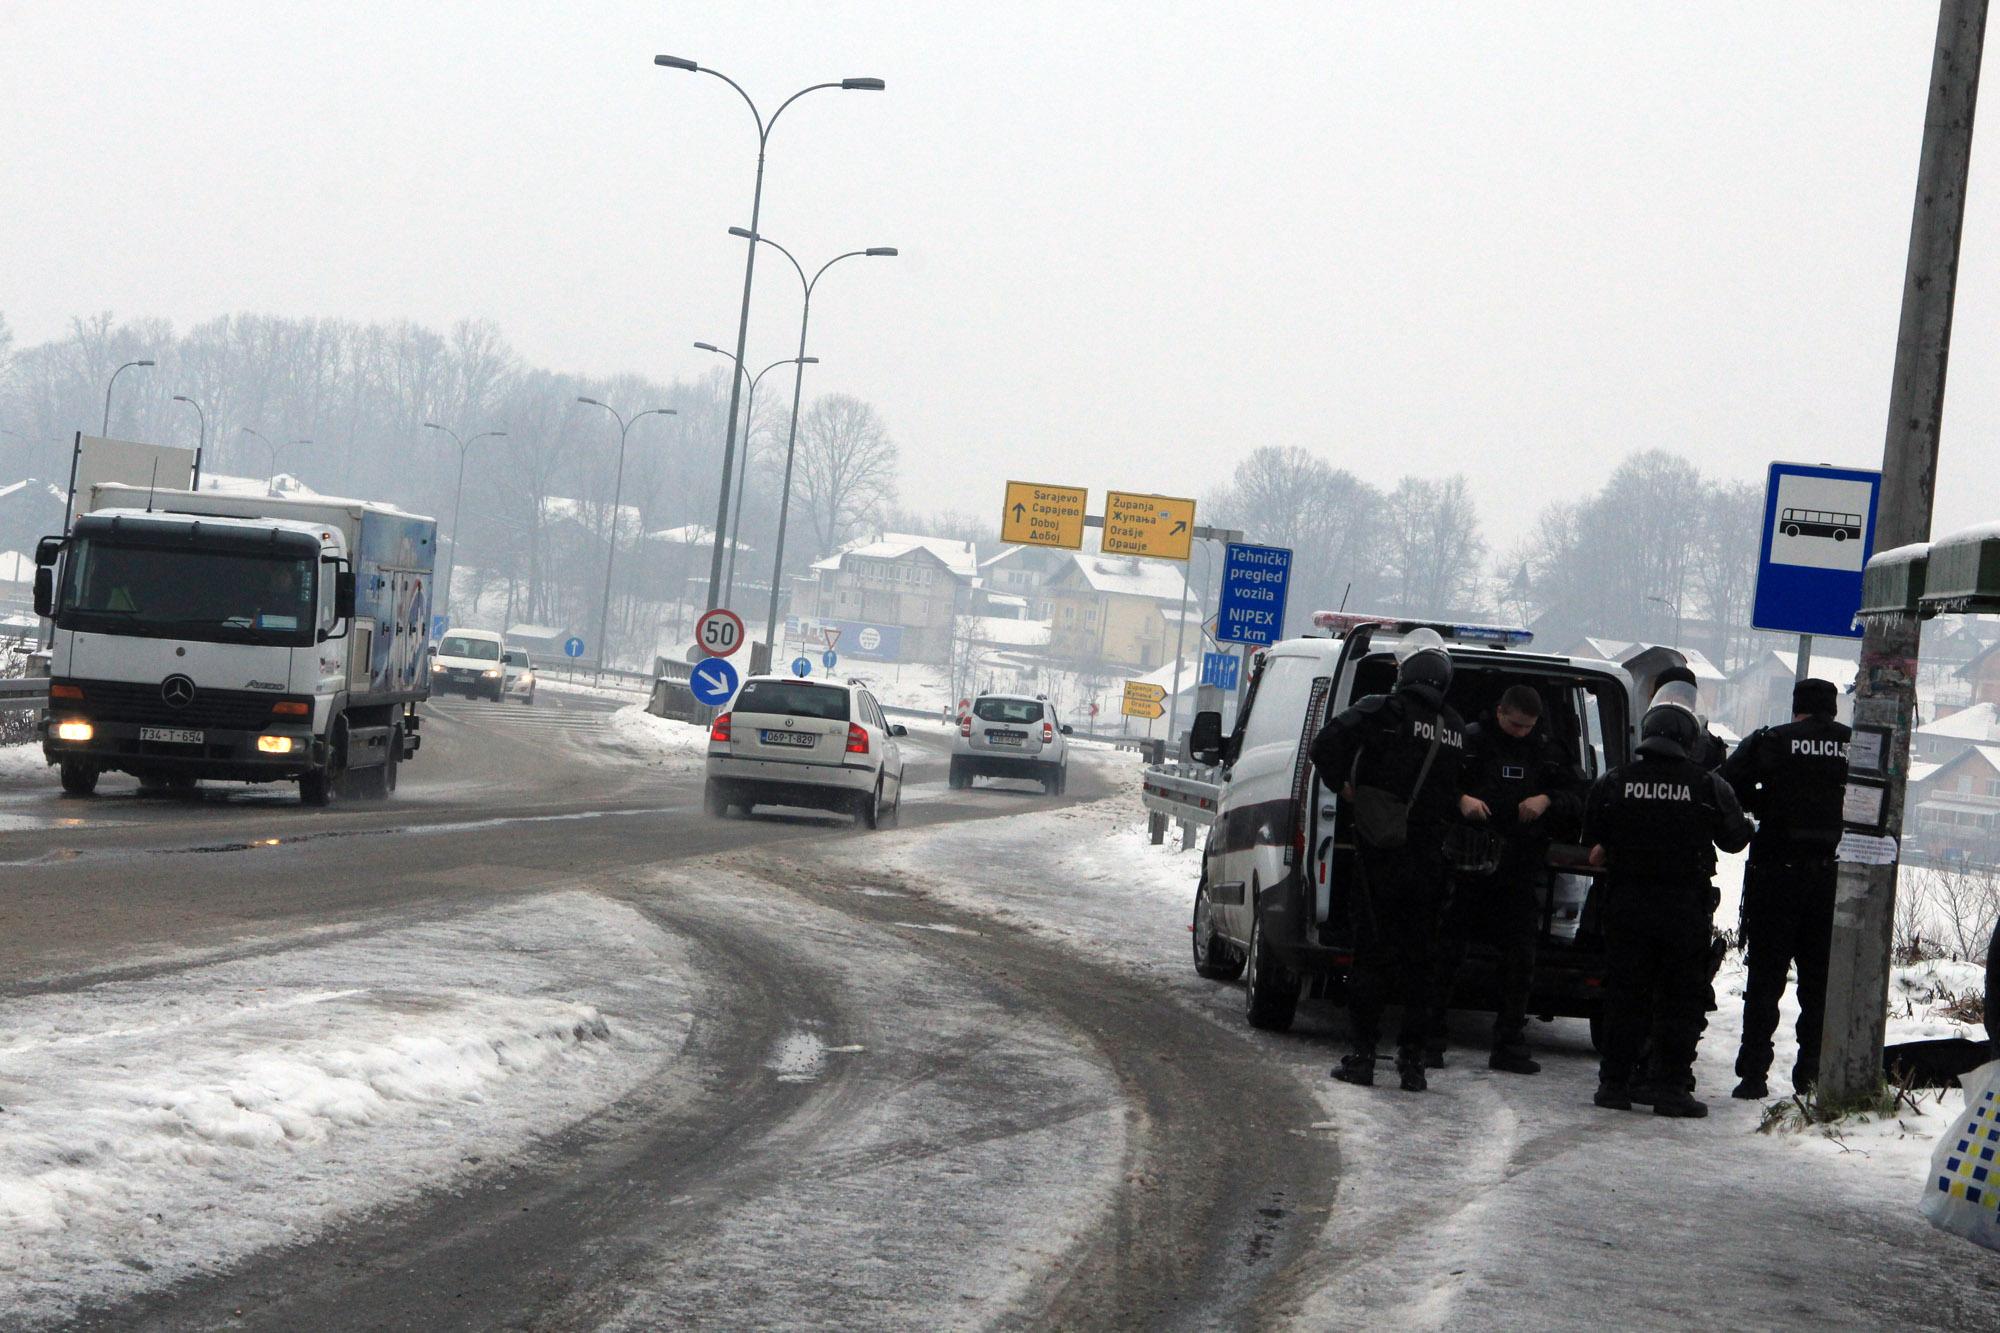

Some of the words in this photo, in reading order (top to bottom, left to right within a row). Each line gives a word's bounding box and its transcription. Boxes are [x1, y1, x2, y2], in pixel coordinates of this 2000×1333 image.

[1034, 490, 1078, 503] Sarajevo
[1032, 503, 1079, 516] Сарајево
[1030, 517, 1059, 531] Doboj
[1110, 525, 1144, 538] Orašje
[1030, 530, 1060, 544] Добој
[1231, 547, 1287, 566] Tehnički
[1230, 568, 1283, 584] pregled
[1234, 588, 1275, 601] vozila
[1229, 607, 1274, 625] NIPEX
[705, 621, 734, 646] 50
[1231, 625, 1241, 638] 5
[1244, 626, 1266, 641] km
[142, 729, 201, 743] 734-T-654
[1414, 720, 1463, 749] POLCIJA
[1624, 782, 1691, 801] POLICIJA
